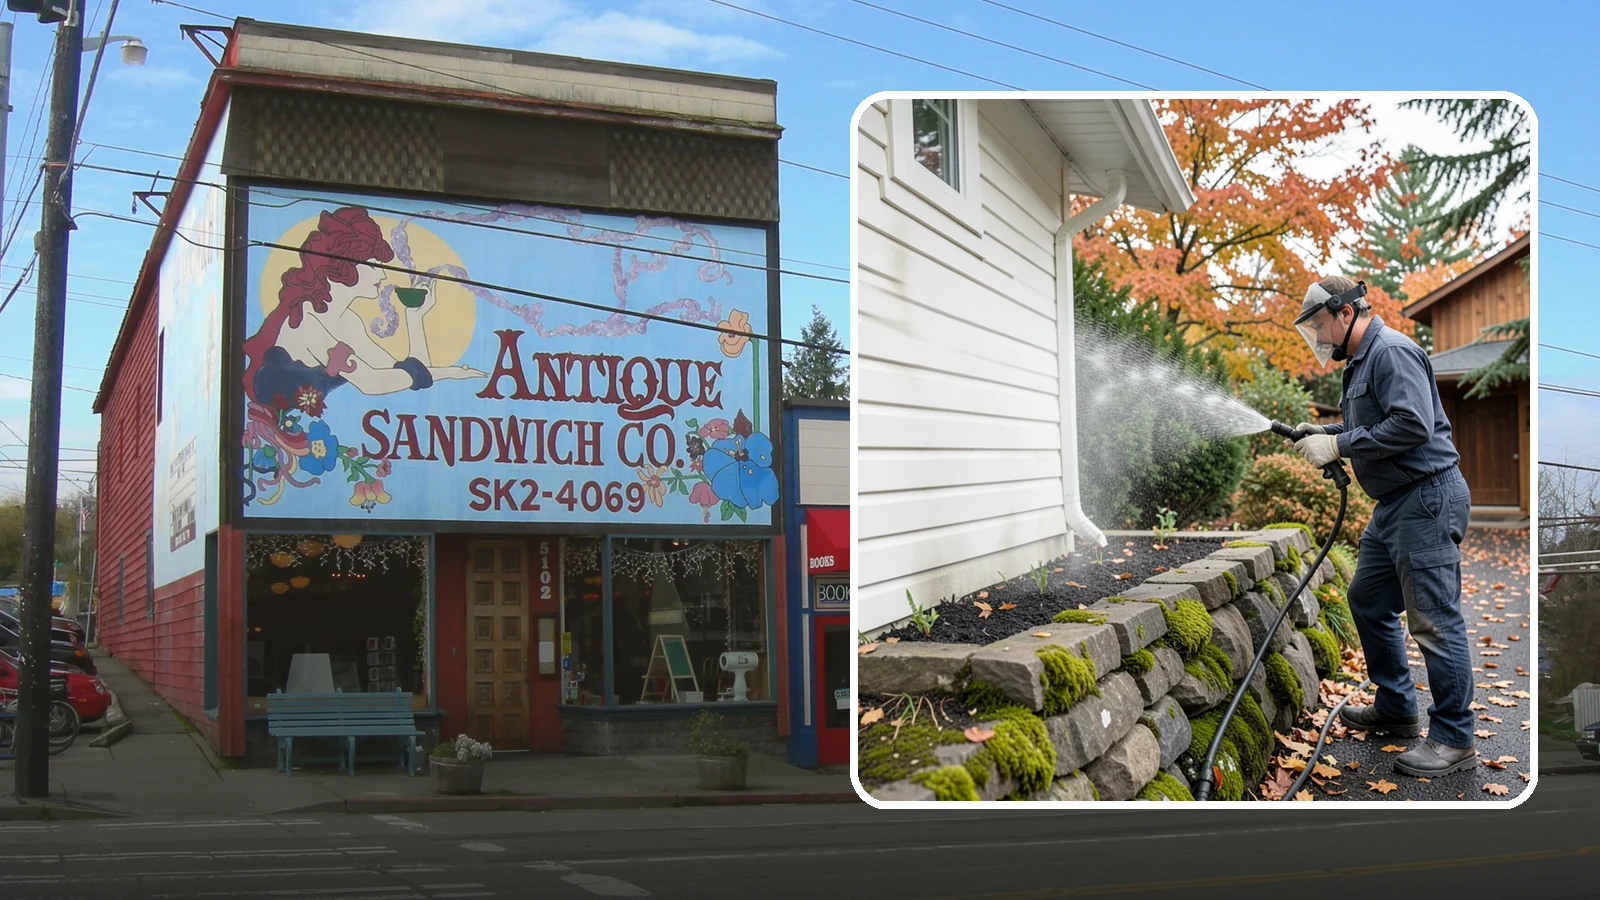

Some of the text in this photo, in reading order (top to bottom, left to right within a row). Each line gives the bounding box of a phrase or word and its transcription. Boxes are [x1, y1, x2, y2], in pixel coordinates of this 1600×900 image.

[476, 329, 723, 421] ANTIQUE
[361, 408, 685, 469] SANDWICH CO.
[468, 477, 645, 513] SK2-4069
[539, 542, 552, 600] 5102
[809, 555, 835, 569] BOOKS
